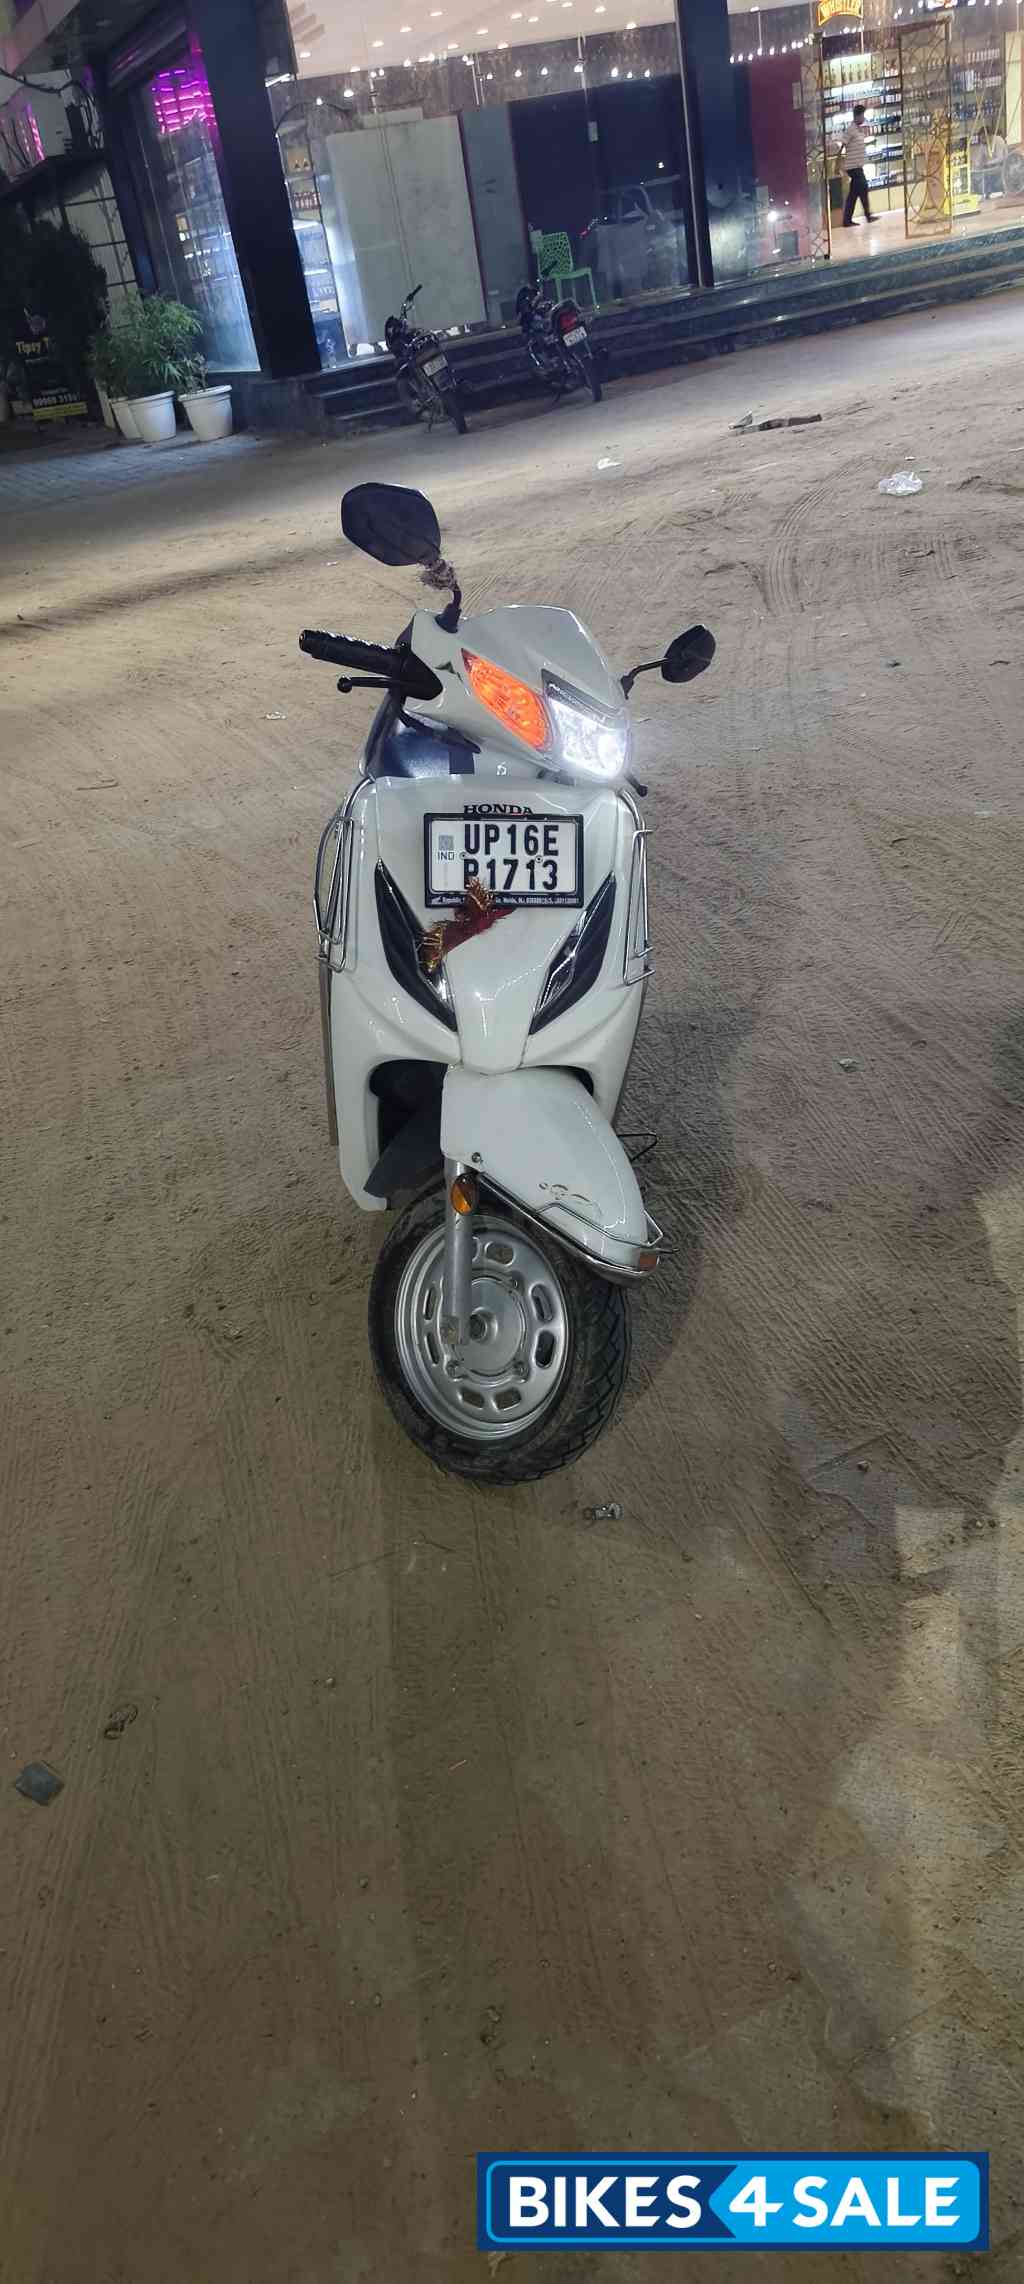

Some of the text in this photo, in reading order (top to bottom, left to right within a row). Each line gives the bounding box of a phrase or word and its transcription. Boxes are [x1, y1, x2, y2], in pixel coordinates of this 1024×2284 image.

[463, 804, 534, 815] HONDA
[464, 823, 559, 857] UP16E
[437, 851, 455, 861] IND
